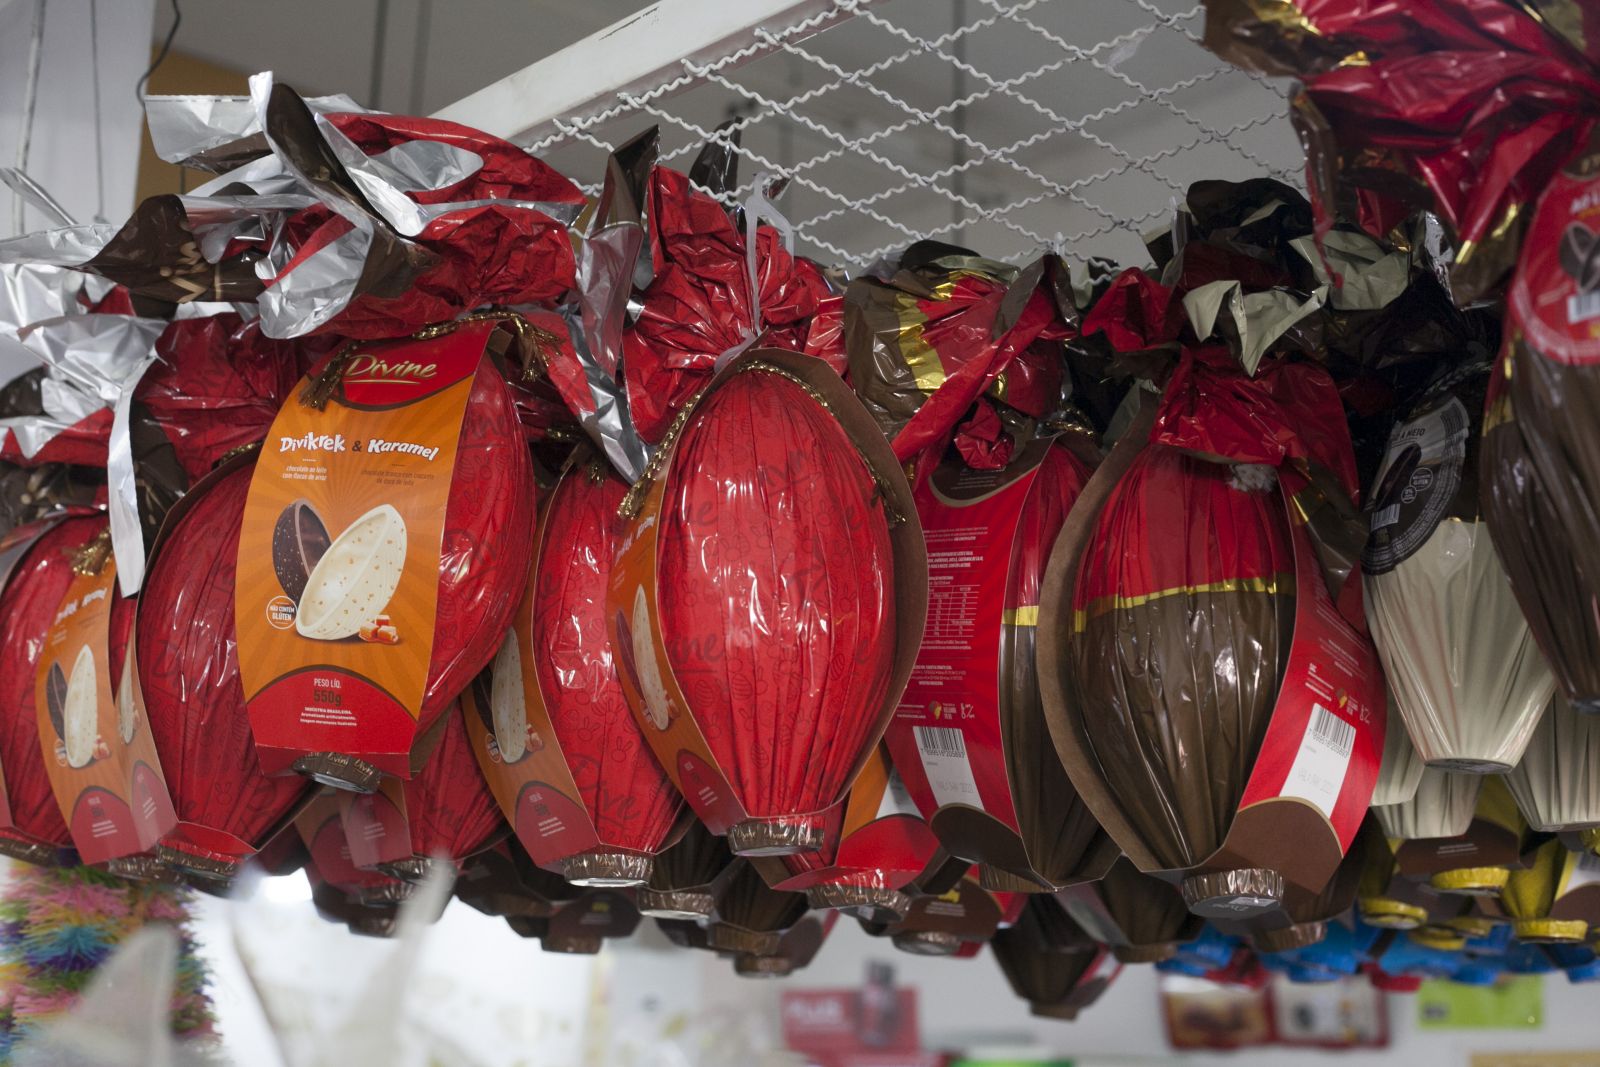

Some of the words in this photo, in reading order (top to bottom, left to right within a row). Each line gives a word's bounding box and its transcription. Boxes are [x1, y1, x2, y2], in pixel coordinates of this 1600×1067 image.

[345, 354, 438, 379] Divine
[279, 431, 346, 453] Divikrek
[352, 440, 362, 452] &
[367, 439, 439, 461] Karamel
[313, 678, 330, 687] PESO
[313, 689, 342, 707] 550g
